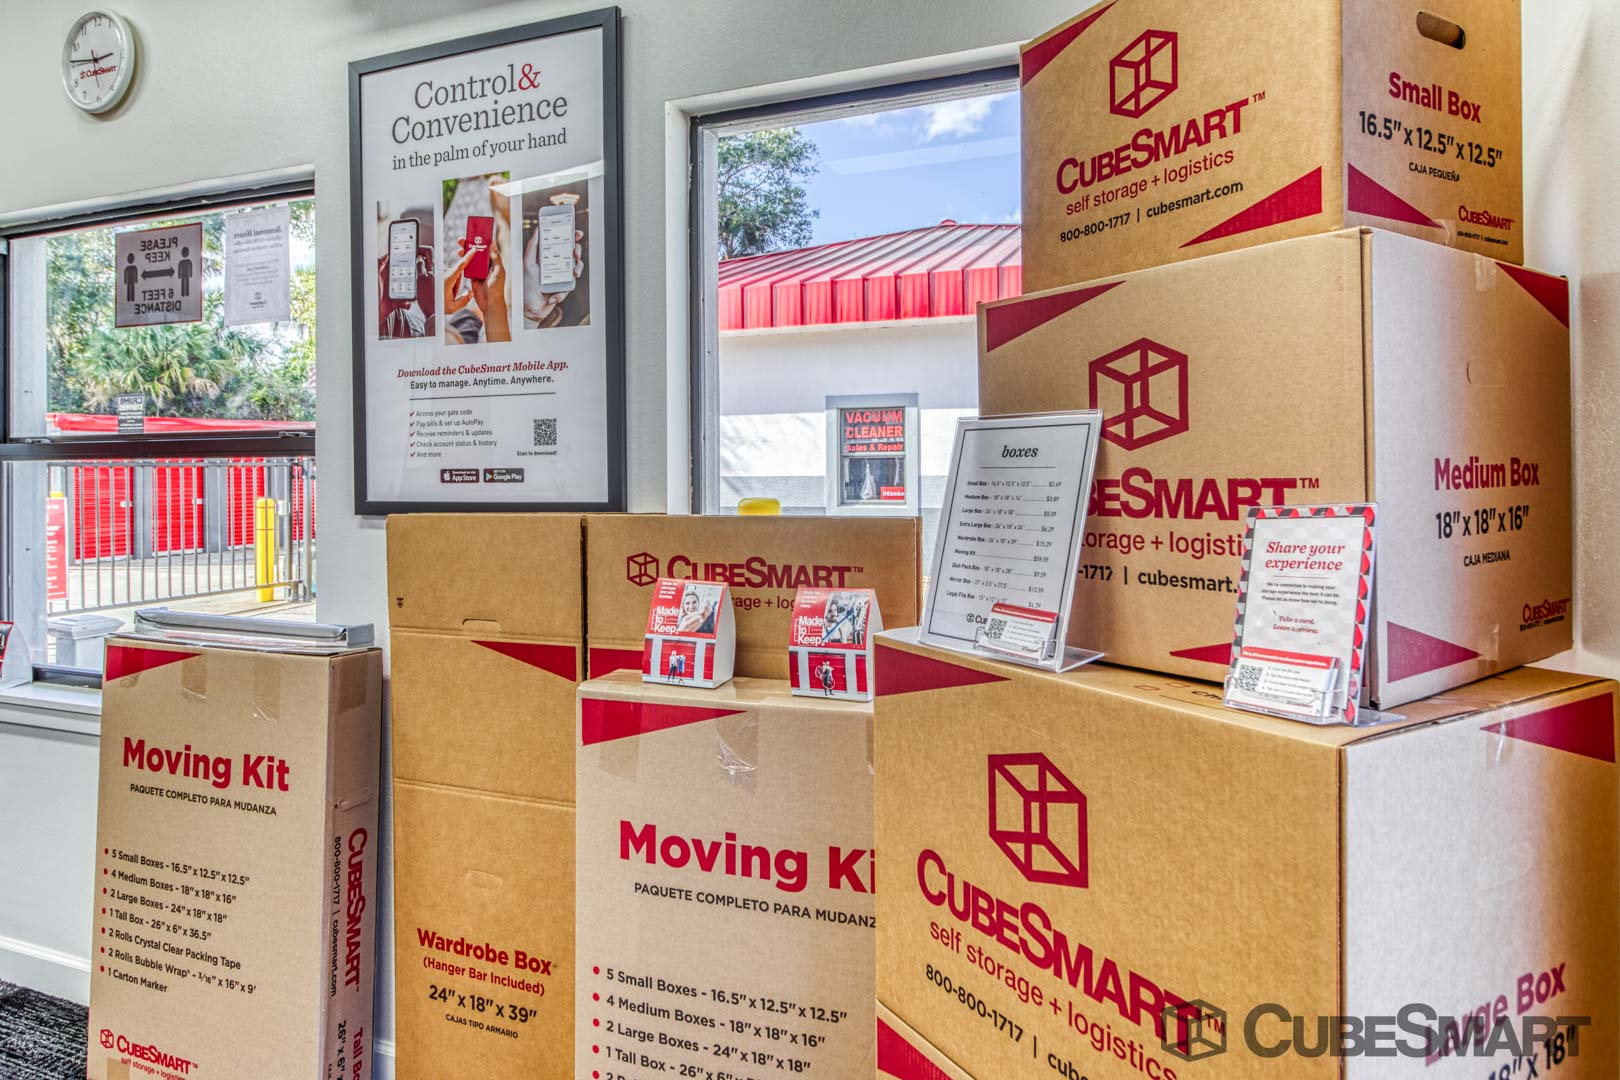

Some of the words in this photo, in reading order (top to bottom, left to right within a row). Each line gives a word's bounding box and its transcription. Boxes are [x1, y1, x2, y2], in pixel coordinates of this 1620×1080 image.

[1389, 72, 1442, 112] Small
[1448, 90, 1482, 124] Box
[392, 96, 568, 144] Convenience
[393, 156, 406, 170] in
[409, 151, 431, 167] the
[434, 145, 469, 166] palm
[472, 140, 489, 156] of
[490, 139, 525, 158] your
[528, 128, 567, 150] hand
[1056, 98, 1249, 194] CUBESMART
[1359, 111, 1401, 140] 16.5"
[1404, 128, 1413, 146] x
[1417, 127, 1454, 155] 12.5"
[1456, 142, 1464, 160] x
[1468, 142, 1503, 168] 12.5"
[1066, 194, 1092, 216] self
[1094, 178, 1147, 207] storage
[1164, 150, 1234, 187] logistics
[1409, 162, 1427, 175] CAJA
[1429, 168, 1460, 182] PEQUEÑA
[1060, 212, 1131, 242] 800-800-1717
[1146, 182, 1244, 218] cubesmart.com
[1458, 205, 1515, 231] CUBESMART
[397, 366, 441, 378] Download
[442, 366, 456, 375] the
[458, 363, 511, 374] CubeSmart
[512, 361, 545, 371] Mobile
[546, 360, 568, 371] App.
[410, 380, 427, 390] Easy
[429, 380, 437, 389] to
[438, 380, 471, 389] manage.
[473, 377, 508, 387] Anytime.
[510, 374, 554, 385] Anywhere.
[471, 429, 492, 437] updates
[845, 410, 902, 423] VACUUM
[846, 426, 902, 438] CLEANER
[478, 440, 497, 448] history
[846, 443, 867, 452] Sales
[869, 443, 875, 451] &
[878, 443, 903, 452] Repair
[1002, 445, 1038, 458] boxes
[1434, 456, 1506, 491] Medium
[1510, 457, 1540, 486] Box
[1436, 511, 1460, 539] 18"
[1462, 515, 1471, 536] x
[1474, 508, 1496, 535] 18"
[1498, 512, 1506, 532] x
[1509, 505, 1529, 531] 16"
[1082, 531, 1144, 554] orage
[1169, 531, 1242, 559] logisti
[1266, 541, 1307, 554] Share
[1308, 544, 1345, 556] your
[1464, 555, 1481, 567] CAJA
[1482, 550, 1510, 564] MEDIANA
[667, 555, 852, 589] CUBESMART
[1265, 557, 1343, 571] experience
[1138, 569, 1238, 594] cubesmart.
[655, 616, 663, 624] to
[656, 606, 679, 616] Made
[799, 616, 822, 625] Made
[654, 624, 679, 634] Keep.
[798, 626, 807, 634] to
[798, 635, 825, 646] Keep.
[123, 736, 232, 789] Moving
[242, 753, 290, 792] Kit
[130, 783, 164, 797] PAQUETE
[166, 790, 208, 804] COMPLETO
[210, 796, 232, 808] PARA
[234, 801, 277, 816] MUDANZA
[332, 836, 341, 905] 800-800-1717
[620, 819, 808, 893] Moving
[345, 827, 368, 986] CUBESMART
[634, 882, 693, 901] PAQUETE
[696, 891, 769, 912] COMPLETO
[774, 902, 812, 919] PARA
[815, 908, 876, 928] MUDANZ
[109, 928, 114, 937] 2
[115, 929, 133, 943] Rolls
[135, 933, 160, 951] Crystal
[163, 943, 183, 956] Clear
[185, 948, 218, 966] Packing
[220, 956, 241, 970] Tape
[417, 928, 509, 966] Wardrobe
[514, 950, 552, 976] Box
[916, 848, 1202, 1056] CUBESMART
[930, 920, 962, 954] self
[966, 943, 1043, 1007] storage
[108, 968, 111, 976] 1
[113, 969, 138, 985] Carton
[140, 976, 167, 992] Marker
[423, 956, 466, 976] (Hanger
[469, 968, 487, 981] Bar
[491, 972, 545, 997] Included)
[429, 984, 455, 1002] 24"
[458, 994, 466, 1008] x
[470, 995, 493, 1012] 18"
[496, 1004, 504, 1018] x
[508, 1005, 537, 1023] 39"
[926, 963, 1023, 1043] 800-800-1717
[1425, 994, 1508, 1068] Large
[1517, 962, 1566, 1016] Box
[445, 1014, 467, 1025] CAJAS
[468, 1019, 484, 1030] TIPO
[485, 1024, 518, 1039] ARMARIO
[117, 1035, 191, 1074] CUBESMART
[352, 1027, 363, 1061] Tall
[133, 1061, 155, 1074] storage
